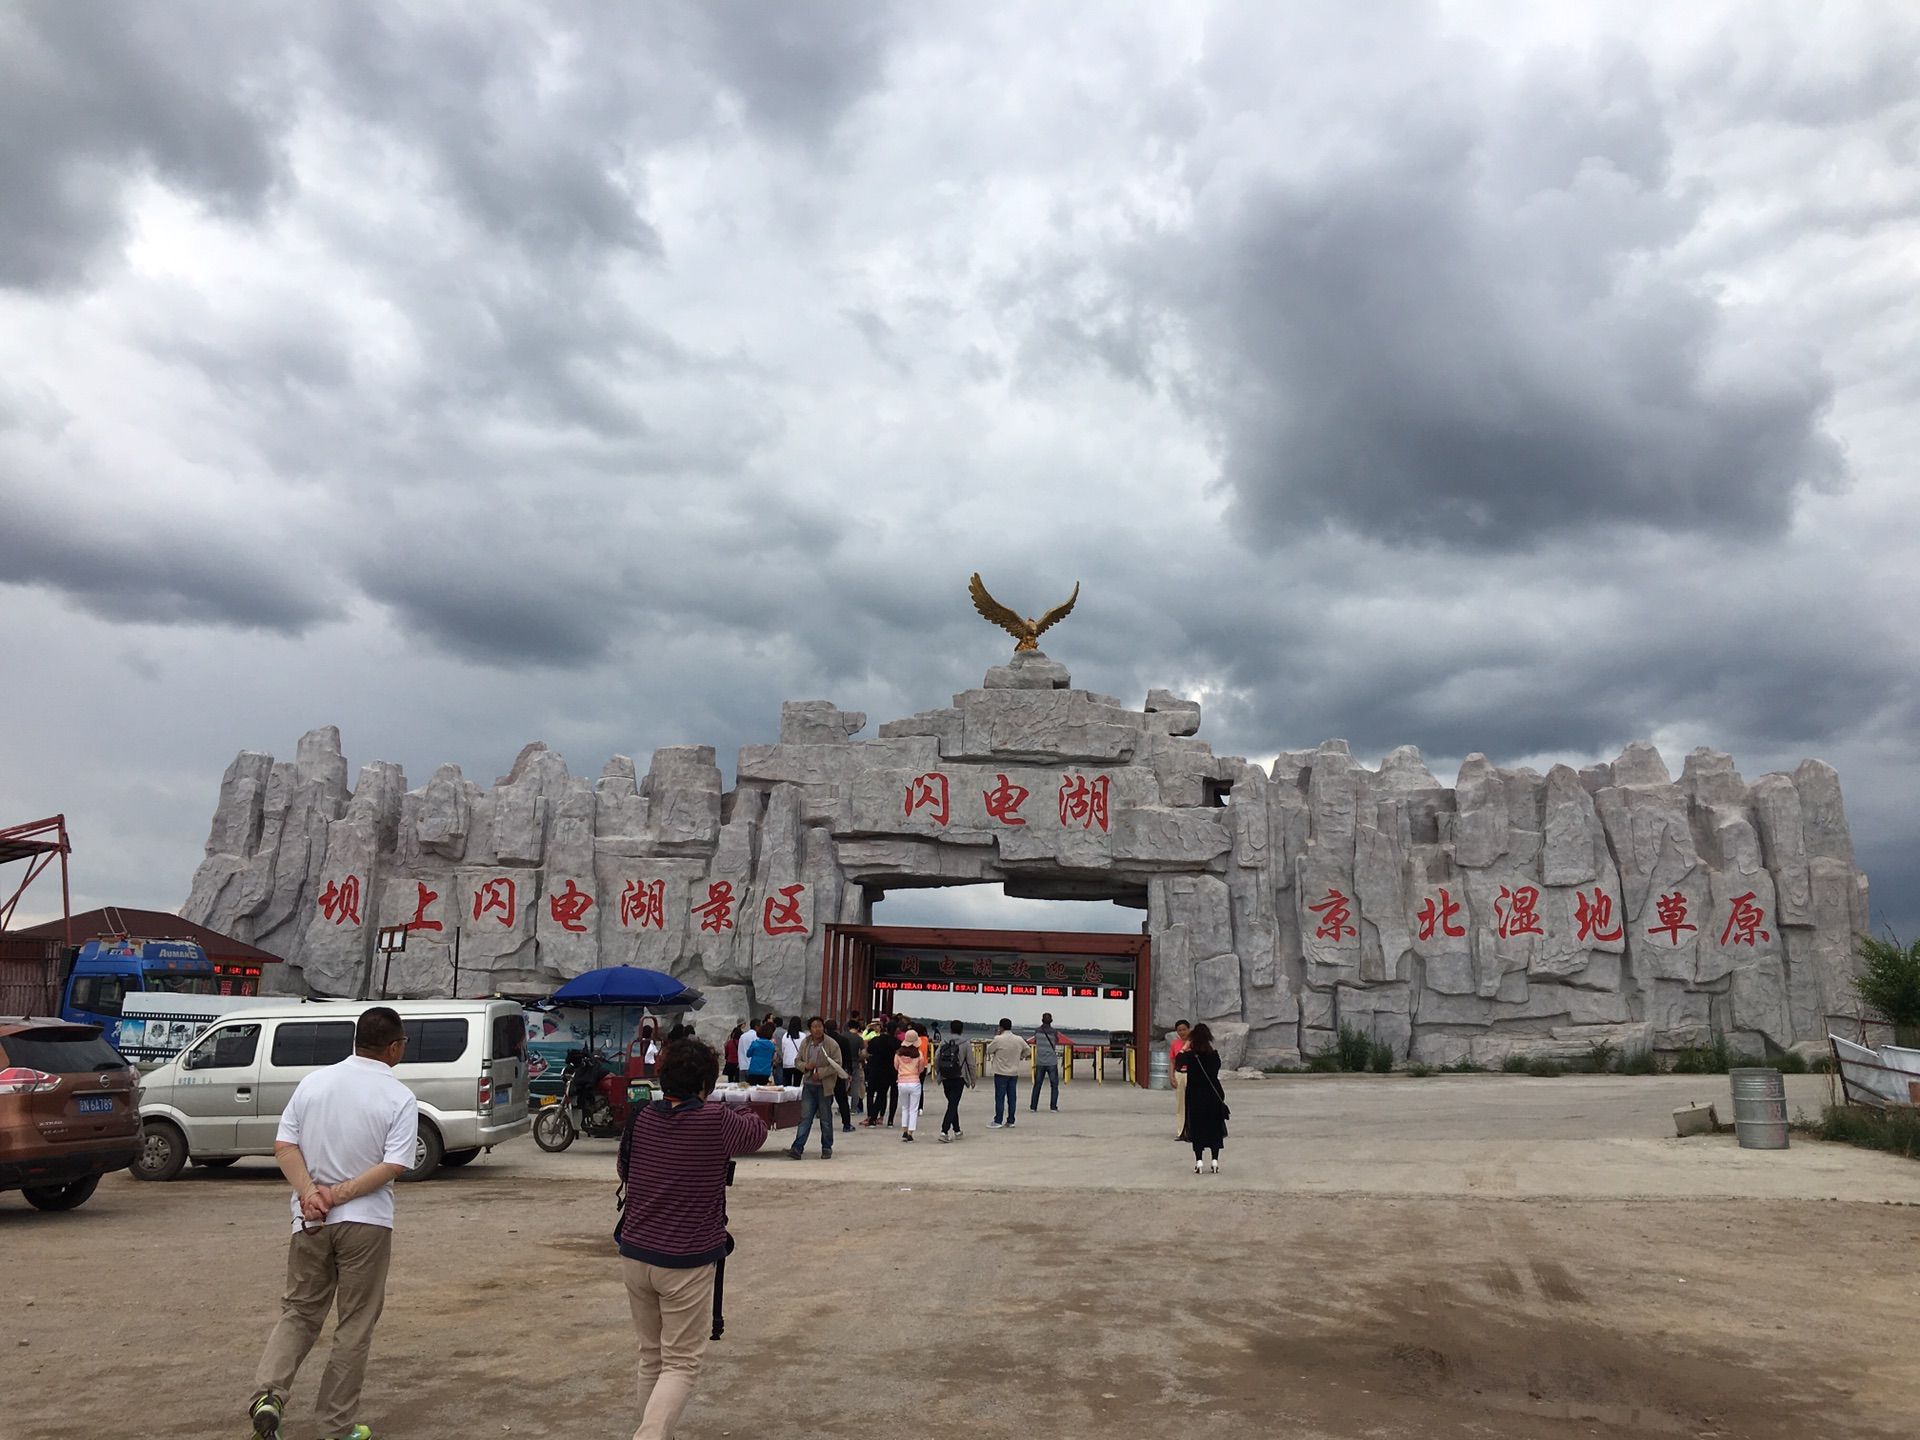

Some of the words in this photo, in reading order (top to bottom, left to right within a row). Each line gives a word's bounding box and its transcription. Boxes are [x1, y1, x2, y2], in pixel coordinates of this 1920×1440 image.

[905, 773, 1109, 832] 闪电湖
[319, 877, 807, 936] 坝上闪电湖景区
[1308, 885, 1771, 947] 京北湿地草原
[901, 956, 1104, 984] 闪电湖欢迎您
